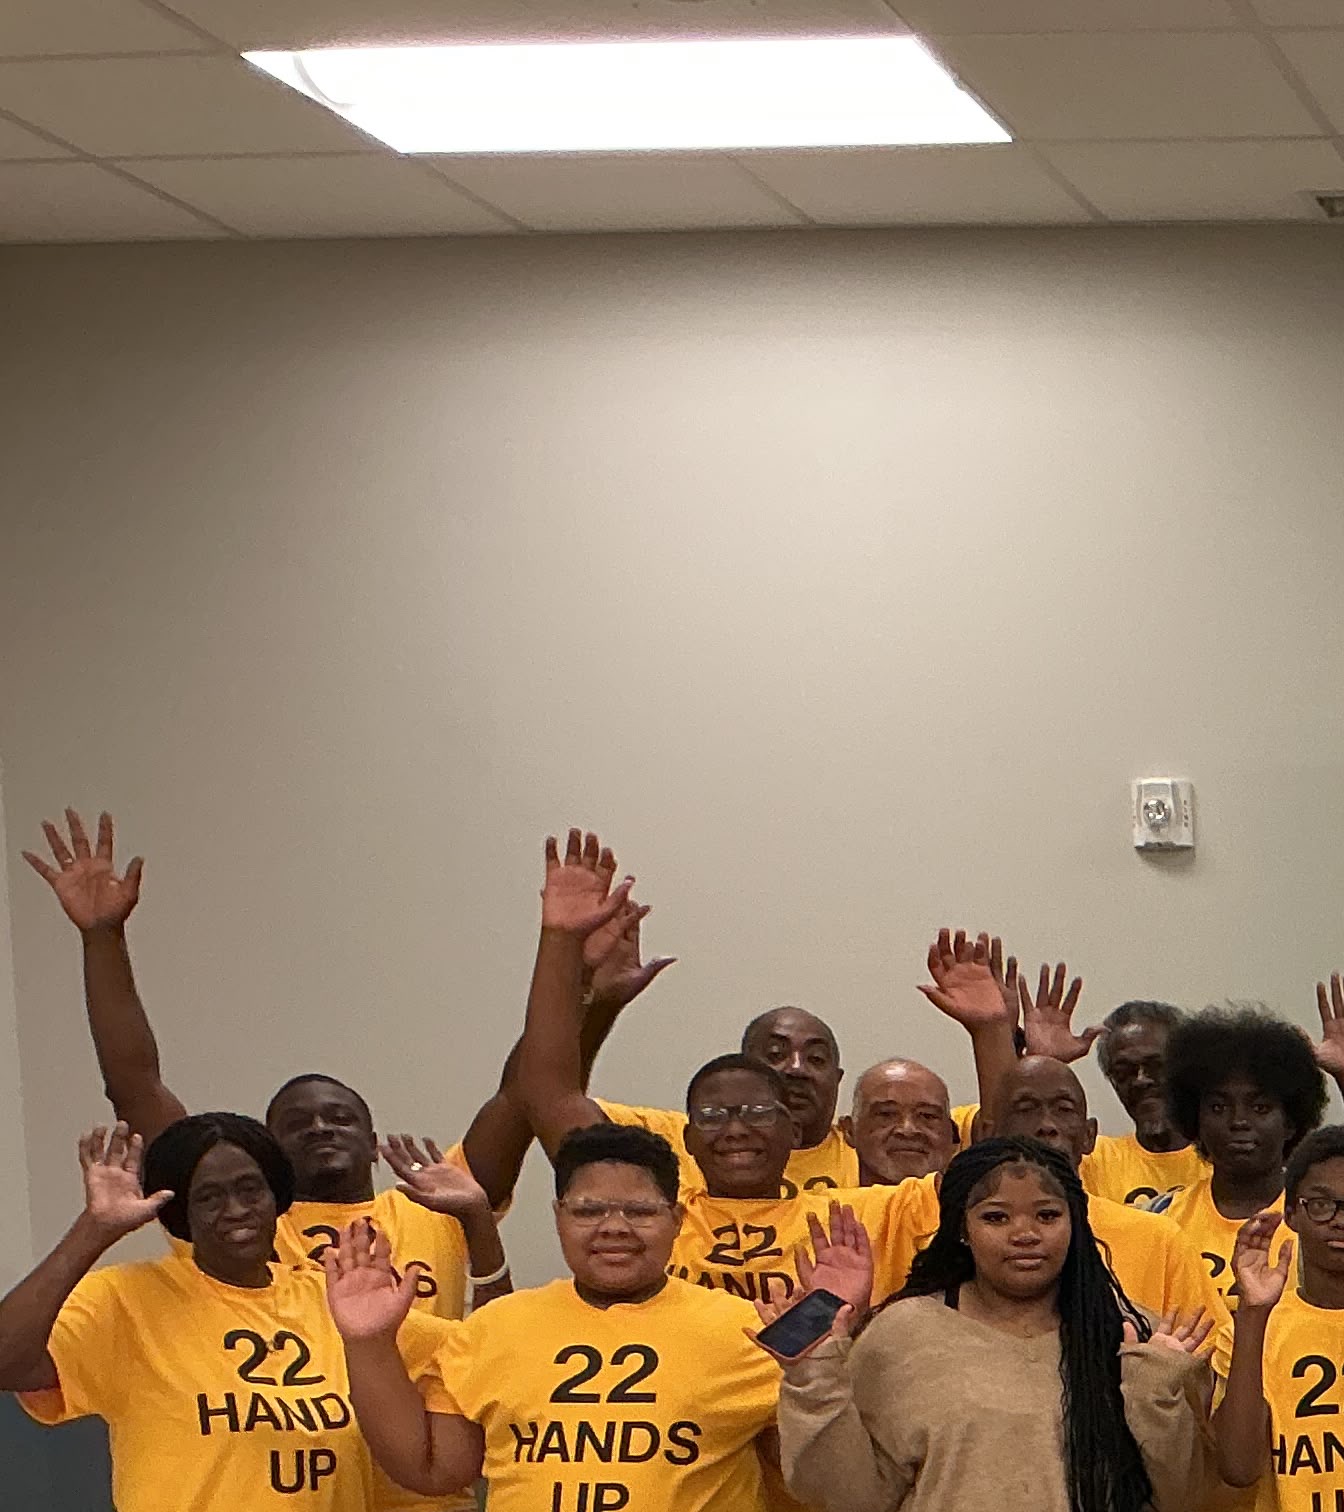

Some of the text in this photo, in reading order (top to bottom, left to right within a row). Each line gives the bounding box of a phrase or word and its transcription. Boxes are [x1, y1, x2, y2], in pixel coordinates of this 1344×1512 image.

[704, 1222, 783, 1266] 22
[223, 1329, 326, 1387] 22
[550, 1344, 659, 1404] 22
[197, 1392, 351, 1435] HAND
[509, 1421, 702, 1466] HANDS
[270, 1448, 337, 1493] UP
